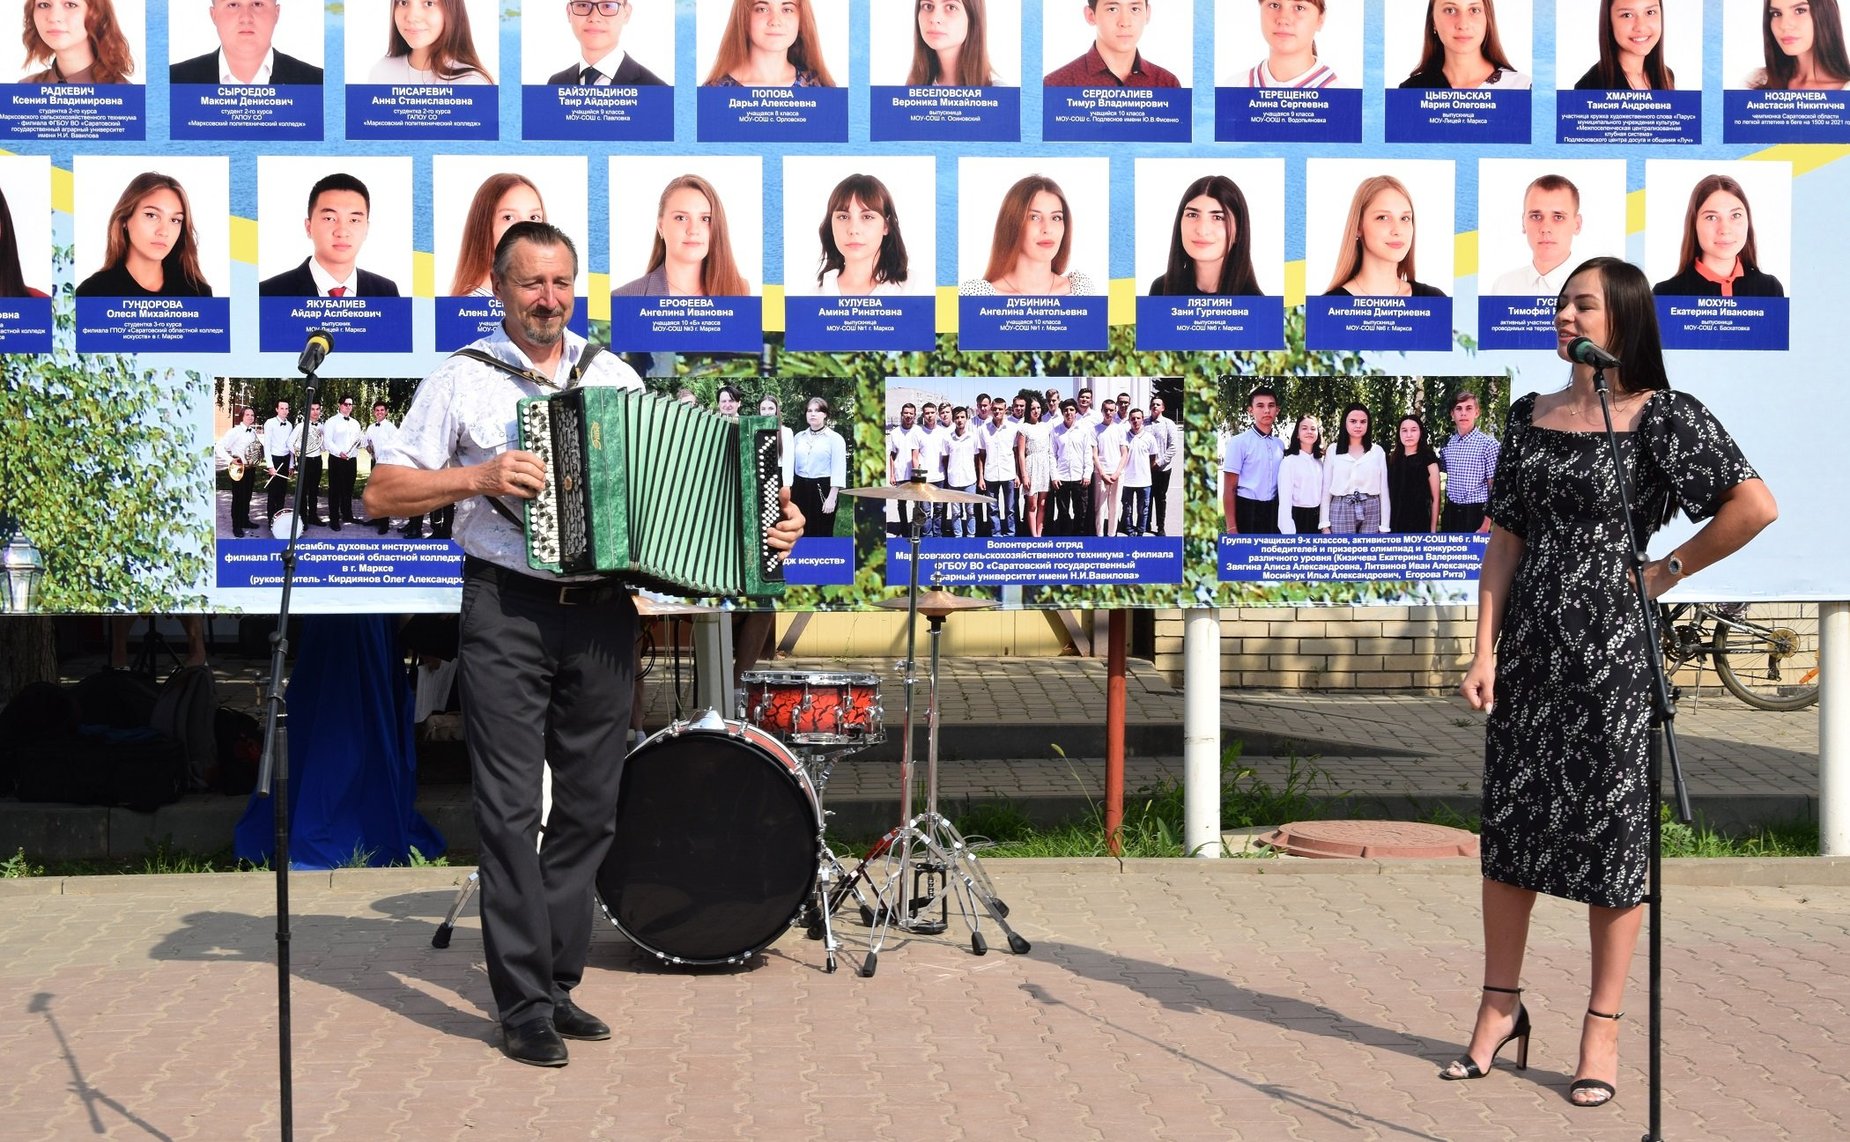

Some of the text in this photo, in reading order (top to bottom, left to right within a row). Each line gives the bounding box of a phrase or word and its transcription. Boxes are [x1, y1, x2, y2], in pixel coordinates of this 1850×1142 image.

[41, 87, 94, 96] РАДКЕВИЧ
[218, 87, 276, 97] СЫРОЕДОВ
[392, 87, 453, 96] ПИСАРЕВИЧ
[558, 87, 638, 97] БАЙЗУЛЬДИНОВ
[752, 90, 794, 98] ПОПОВА
[909, 88, 981, 97] ВЕСЕЛОВСКАЯ
[1082, 89, 1153, 99] СЕРДОГАЛИЕВ
[1259, 91, 1319, 100] ТЕРЕЩЕНКО
[1425, 91, 1491, 101] ЦЫБУЛЬСКАЯ
[1606, 92, 1652, 100] ХМАРИНА
[13, 96, 123, 106] Ксения Владимировна
[372, 96, 473, 105] Анна Станиславовна
[1765, 92, 1827, 101] НОЗДРАЧЕВА
[201, 97, 293, 106] Максим Денисович
[559, 97, 637, 107] Таир Айдарович
[729, 98, 816, 108] Дарья Алексеевна
[892, 98, 998, 108] Вероника Михайловна
[1067, 98, 1168, 108] Тимур Владимирович
[1249, 100, 1329, 109] Алина Сергеевна
[1420, 100, 1496, 110] Мария Олеговна
[1587, 101, 1671, 110] Таисия Андреевна
[1747, 101, 1845, 109] Анастасия Никитична
[123, 300, 183, 310] ГУНДОРОВА
[306, 300, 366, 308] ЯКУБАЛИЕВ
[660, 299, 714, 307] ЕРОФЕЕВА
[838, 298, 882, 307] КУЛУЕВА
[1007, 298, 1060, 308] ДУБИНИНА
[1187, 298, 1232, 307] ЛЯЗГИЯН
[1353, 298, 1406, 307] ЛЕОНКИНА
[1698, 299, 1737, 307] МОХУНЬ
[107, 310, 199, 318] Олеся Михайловна
[291, 309, 322, 319] Айдар
[458, 309, 484, 317] Алена
[640, 308, 733, 316] Ангелина Ивановна
[818, 308, 902, 316] Амина Ринатовна
[979, 307, 1087, 316] Ангелина Анатольевна
[1171, 307, 1249, 317] Зани Гургеновна
[1328, 307, 1430, 317] Ангелина Дмитриевна
[1508, 307, 1550, 316] Тимофей
[1671, 307, 1764, 317] Екатерина Ивановна
[1222, 536, 1252, 545] Группа
[1472, 535, 1490, 544] Мар
[337, 543, 379, 551] духовых
[382, 543, 449, 552] инструментов
[987, 540, 1083, 550] Волонтерский отряд
[1261, 544, 1318, 554] победителей
[1423, 545, 1468, 554] конкурсов
[224, 553, 268, 563] филиала
[298, 553, 365, 563] «Саратовский
[367, 553, 418, 561] областной
[963, 551, 1074, 559] сельскохозяйственного
[1075, 552, 1124, 560] техникума
[1132, 550, 1174, 560] филиала
[1249, 553, 1299, 563] различного
[1332, 553, 1377, 563] (Кизичева
[1379, 553, 1424, 563] Екатерина
[1425, 553, 1480, 563] Валериевна,
[798, 558, 845, 566] искусств»
[934, 561, 1135, 572] ФГБОУ ВО «Саратовский государственный
[1226, 562, 1262, 570] Звягина
[1293, 563, 1362, 571] Александровна,
[1432, 562, 1482, 571] Александро
[359, 564, 394, 573] Марксе
[977, 571, 1037, 582] университет
[1070, 571, 1139, 580] Н.И.Вавилова»
[1263, 570, 1466, 580] Мосийчук Илья Александрович, Егорова Рита)
[250, 575, 320, 585] (руковоитель
[328, 575, 381, 584] Кирдиянов
[383, 575, 406, 583] Олег
[408, 575, 464, 584] Александро
